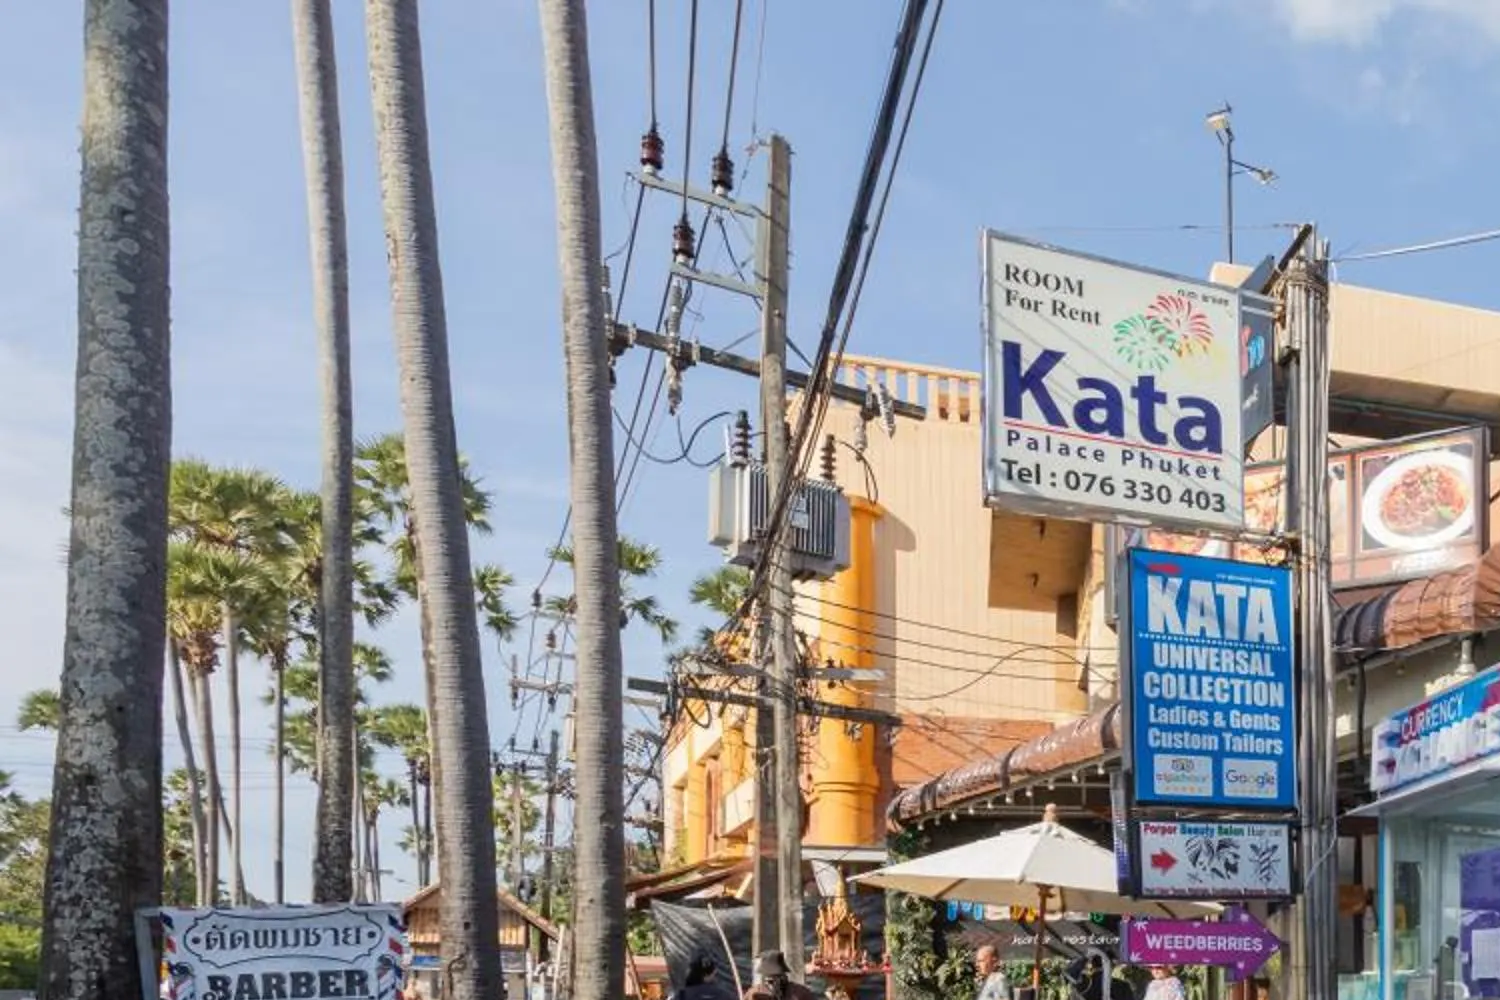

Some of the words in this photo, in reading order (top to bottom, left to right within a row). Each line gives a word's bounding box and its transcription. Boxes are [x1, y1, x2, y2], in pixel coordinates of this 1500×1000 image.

[1005, 263, 1084, 297] ROOM
[1005, 289, 1044, 313] For
[1052, 299, 1101, 326] Rent
[1001, 340, 1223, 454] Kata
[1007, 431, 1105, 461] Palace
[1121, 449, 1221, 481] Phuket
[1064, 470, 1115, 496] 076
[1123, 478, 1172, 505] 330
[1179, 486, 1226, 513] 403
[1147, 575, 1279, 644] KATA
[1153, 642, 1275, 677] UNIVERSAL
[1143, 671, 1284, 708] COLLECTION
[1149, 703, 1209, 726] Ladies
[1213, 711, 1226, 728] &
[1229, 709, 1281, 732] Gents
[1148, 727, 1219, 751] Custom
[1222, 732, 1283, 755] Tailors
[1226, 769, 1275, 788] Google
[1145, 933, 1263, 952] WEEDBERRIES
